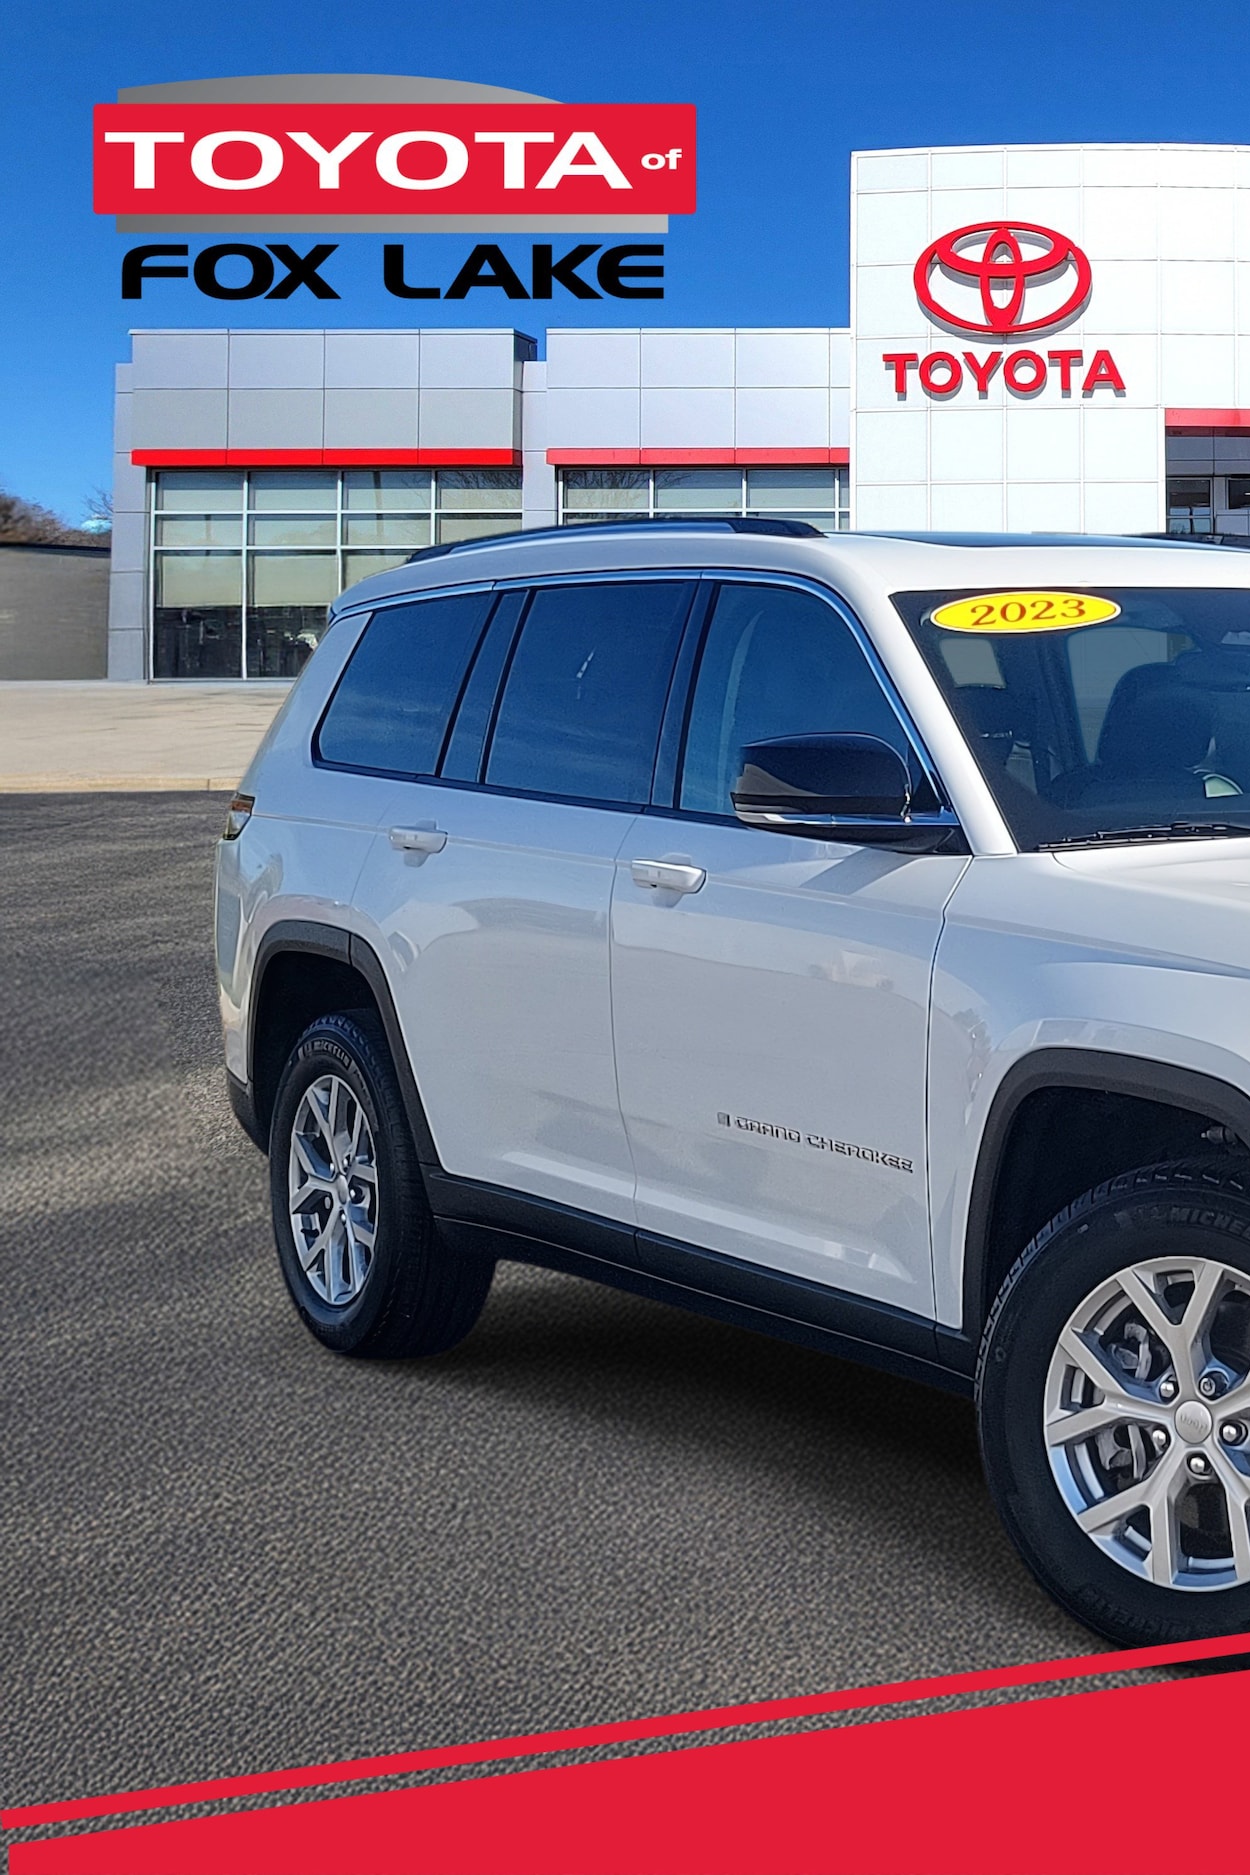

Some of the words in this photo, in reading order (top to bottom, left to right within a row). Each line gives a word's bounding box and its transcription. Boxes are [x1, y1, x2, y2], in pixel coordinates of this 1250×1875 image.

[882, 349, 1127, 398] TOYOTA
[970, 598, 1086, 627] 2023
[733, 1115, 801, 1144] GRAND
[806, 1133, 914, 1174] CHEROKEE
